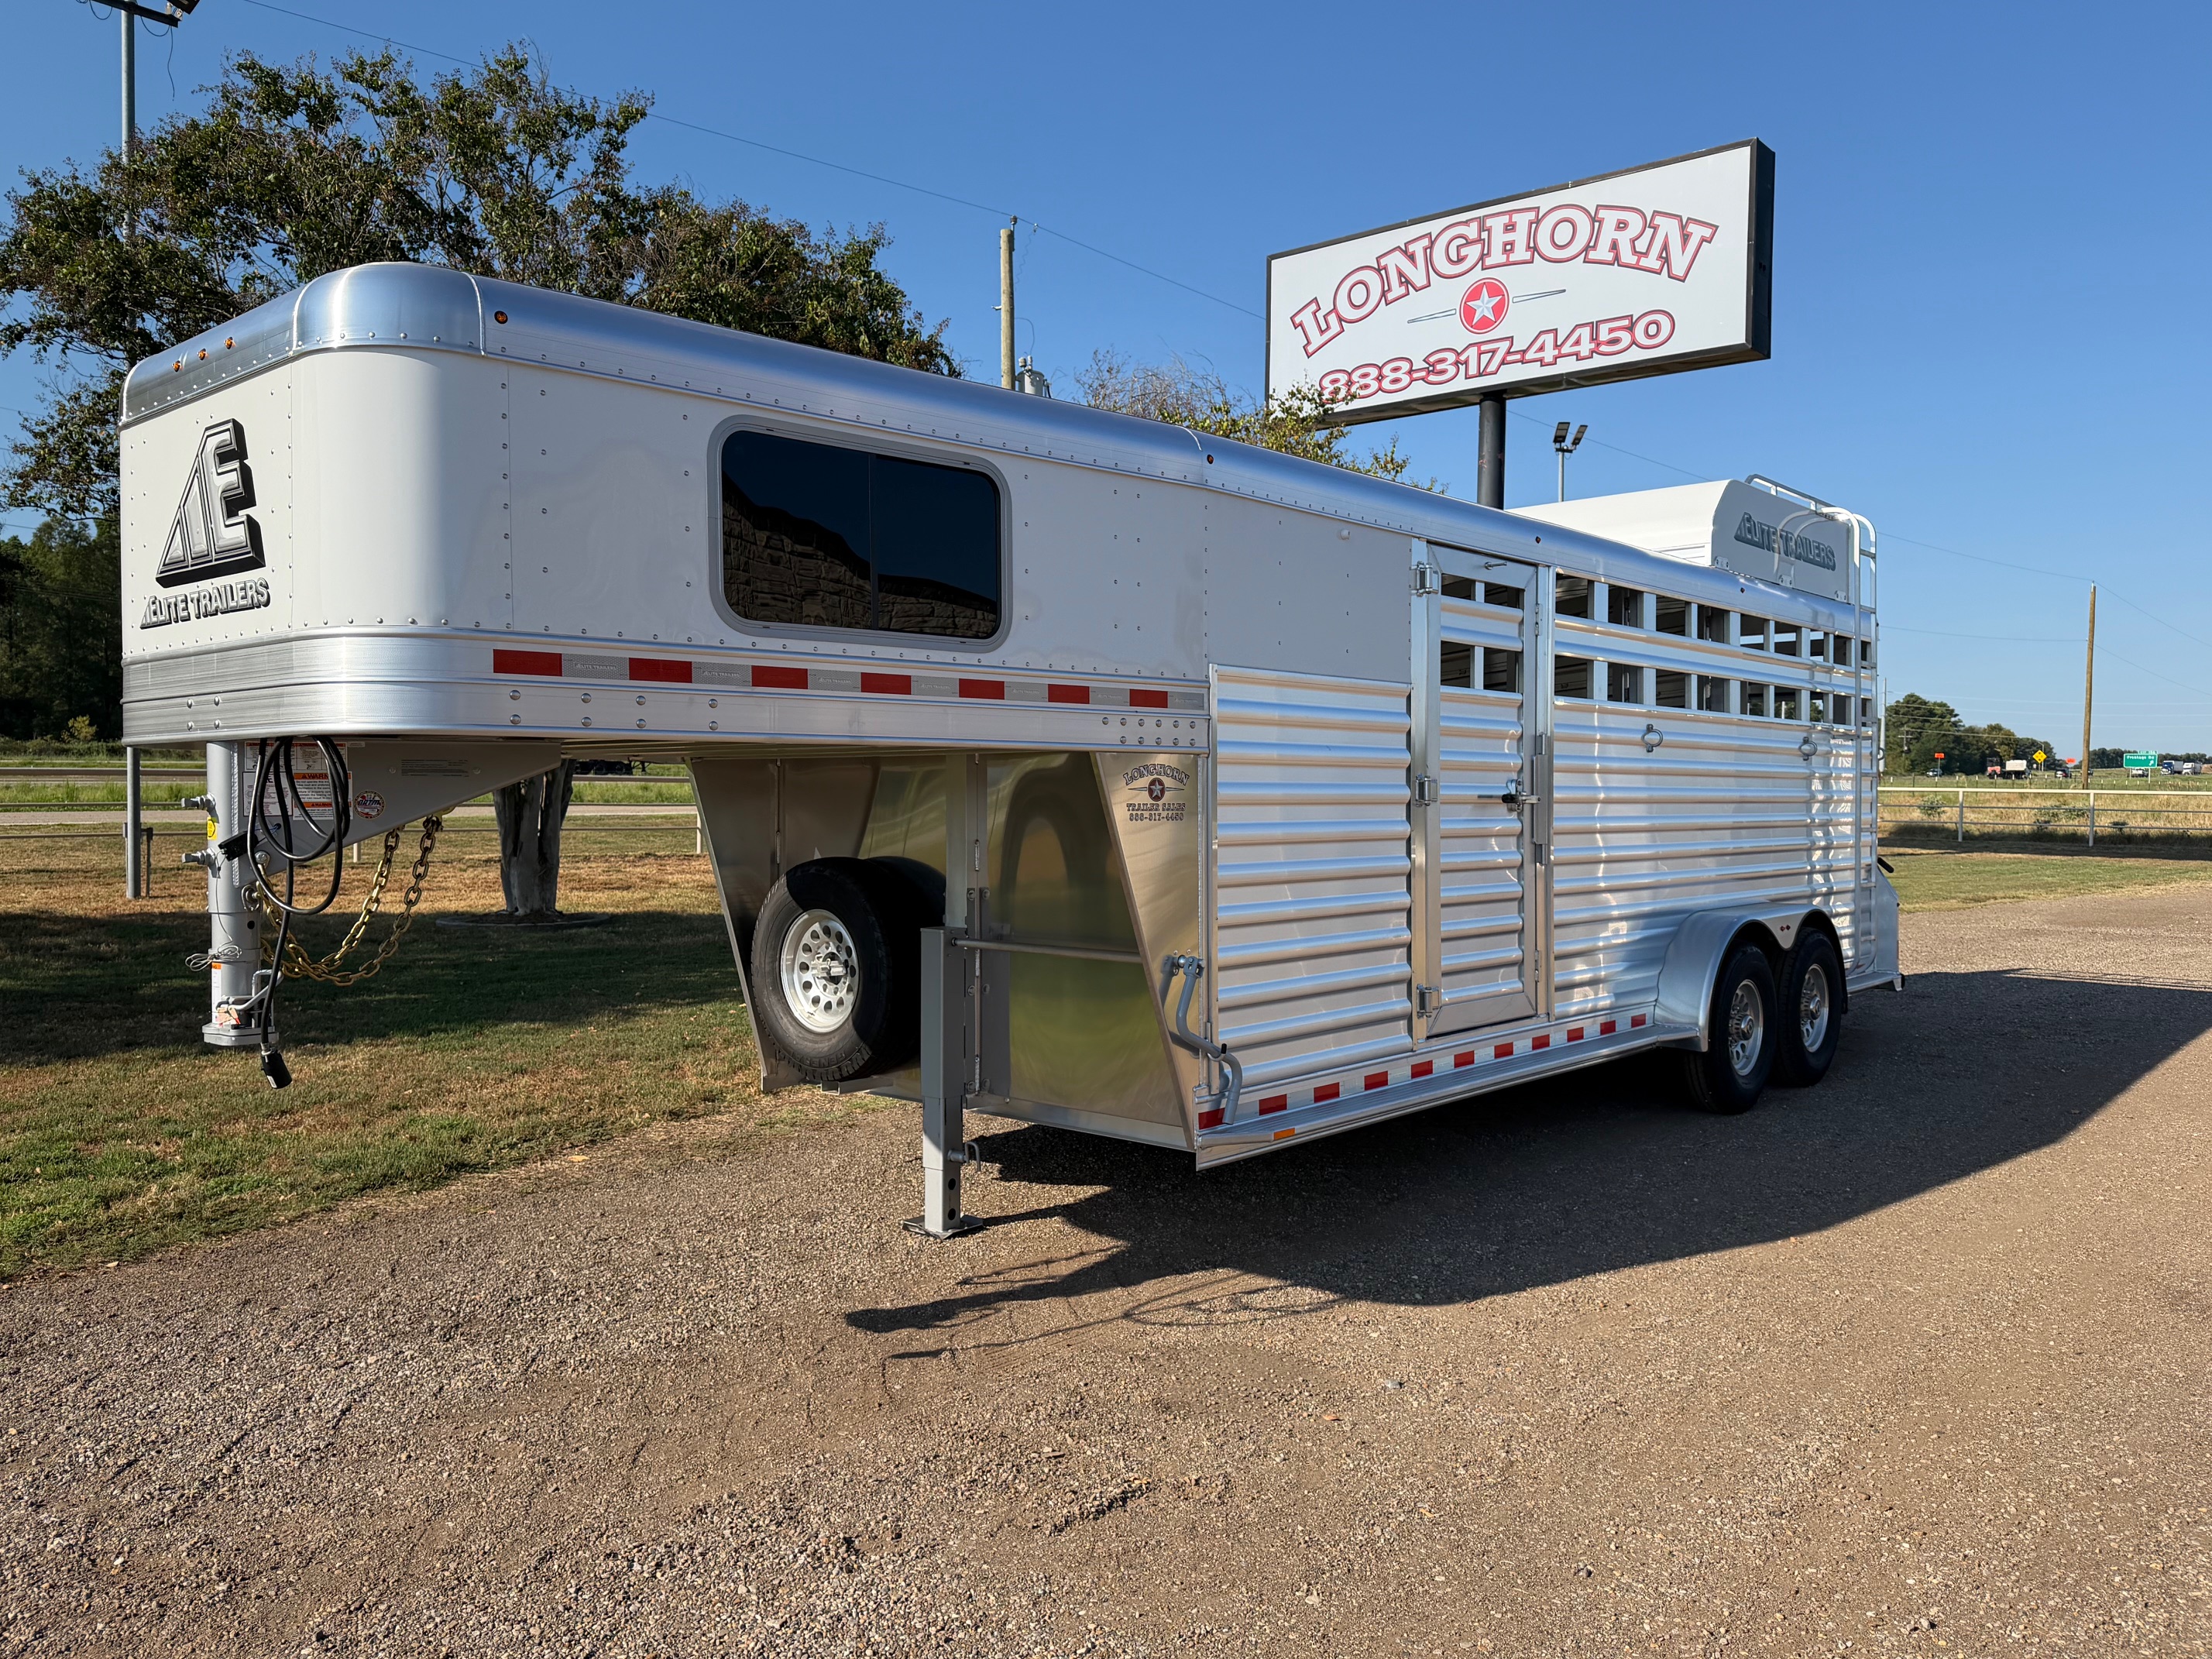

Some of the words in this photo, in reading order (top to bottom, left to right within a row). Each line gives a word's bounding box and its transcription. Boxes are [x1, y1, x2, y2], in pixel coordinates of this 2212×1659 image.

[1290, 204, 1719, 358] LONGHORN
[1319, 310, 1675, 404] 888-317-4450
[1734, 512, 1780, 555] ELITE
[1779, 528, 1836, 572] TRAILERS
[140, 596, 191, 630] ELITE
[189, 577, 270, 620] TRAILERS
[1123, 764, 1190, 785] LONGHORN
[1126, 803, 1160, 812] TRAILER
[1162, 803, 1187, 812] SALES
[1128, 812, 1184, 821] 888-317-4450
